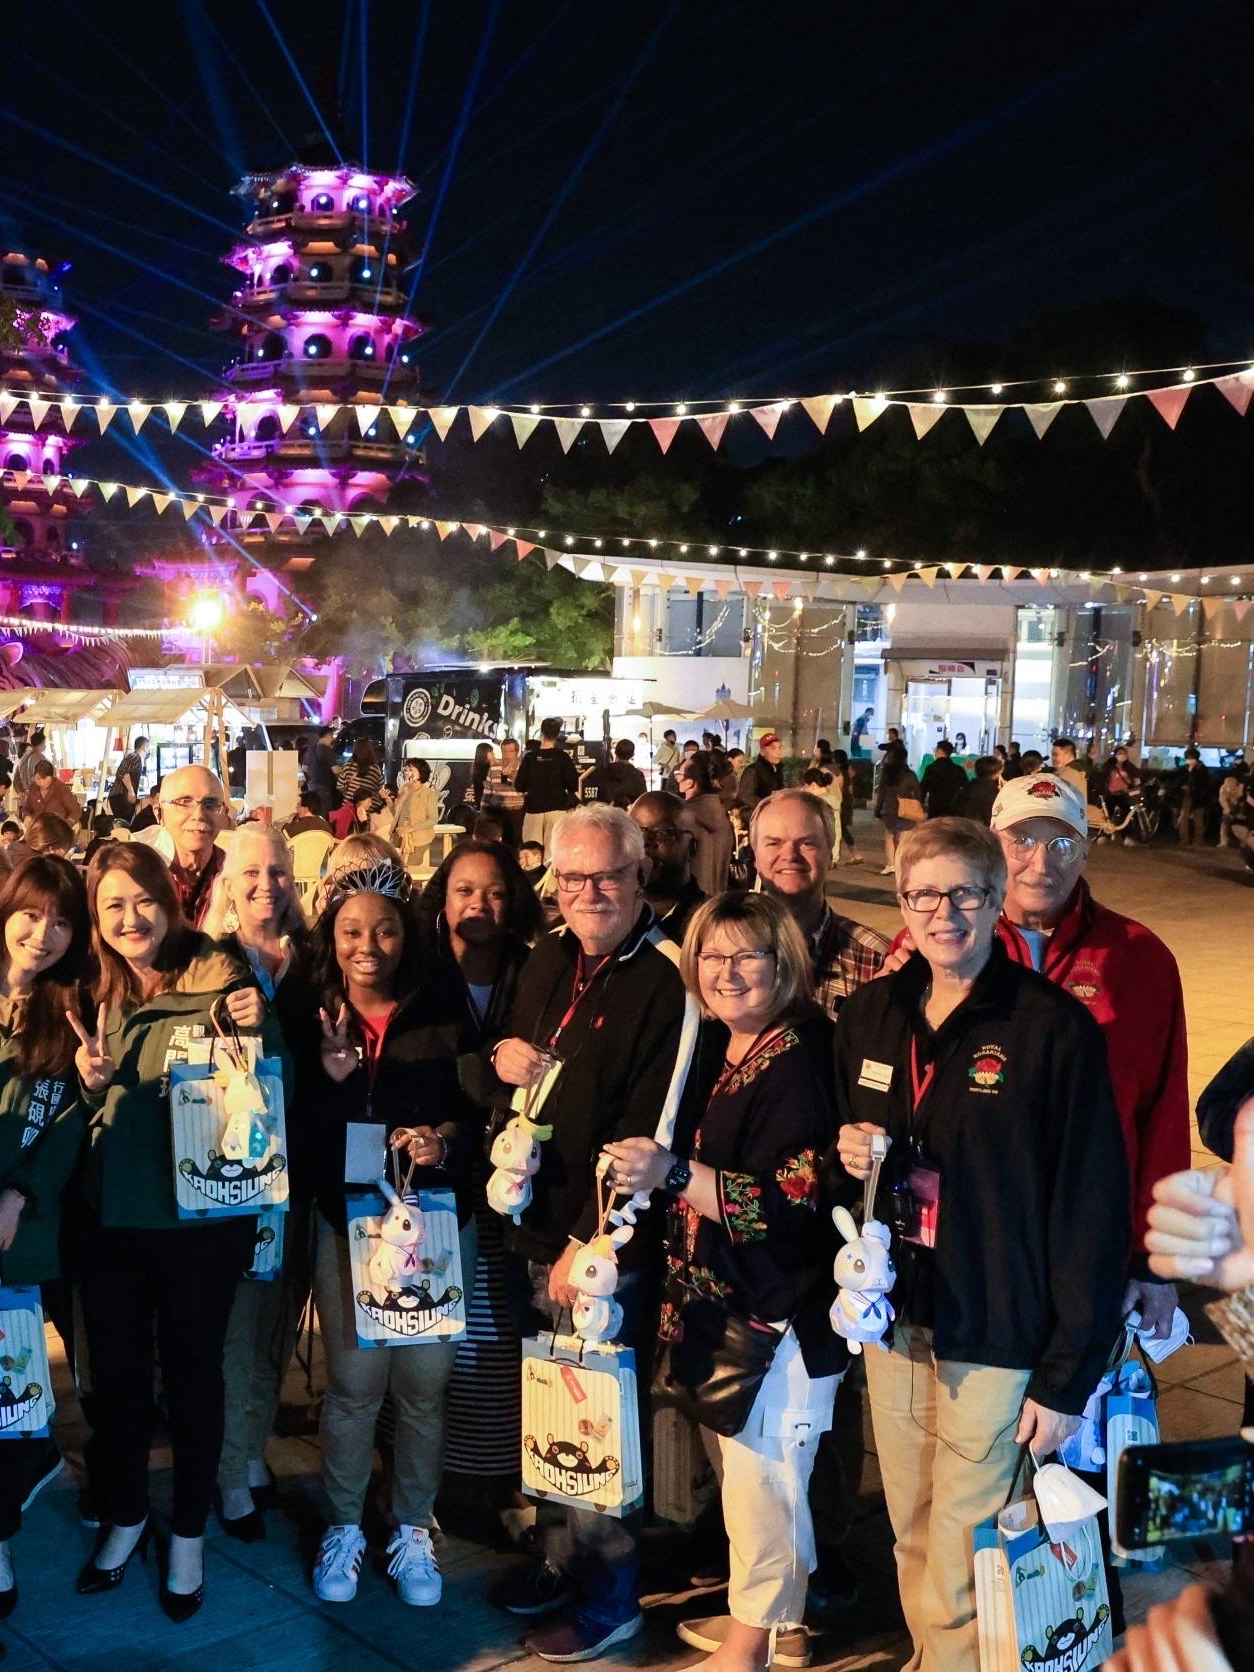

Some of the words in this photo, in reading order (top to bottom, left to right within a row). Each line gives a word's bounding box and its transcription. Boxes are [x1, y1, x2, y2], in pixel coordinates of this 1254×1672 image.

[181, 1166, 283, 1206] KAOHSIUNG
[357, 1296, 461, 1336] KAOHSIUNG
[527, 1447, 617, 1496] KAOHSIUNG
